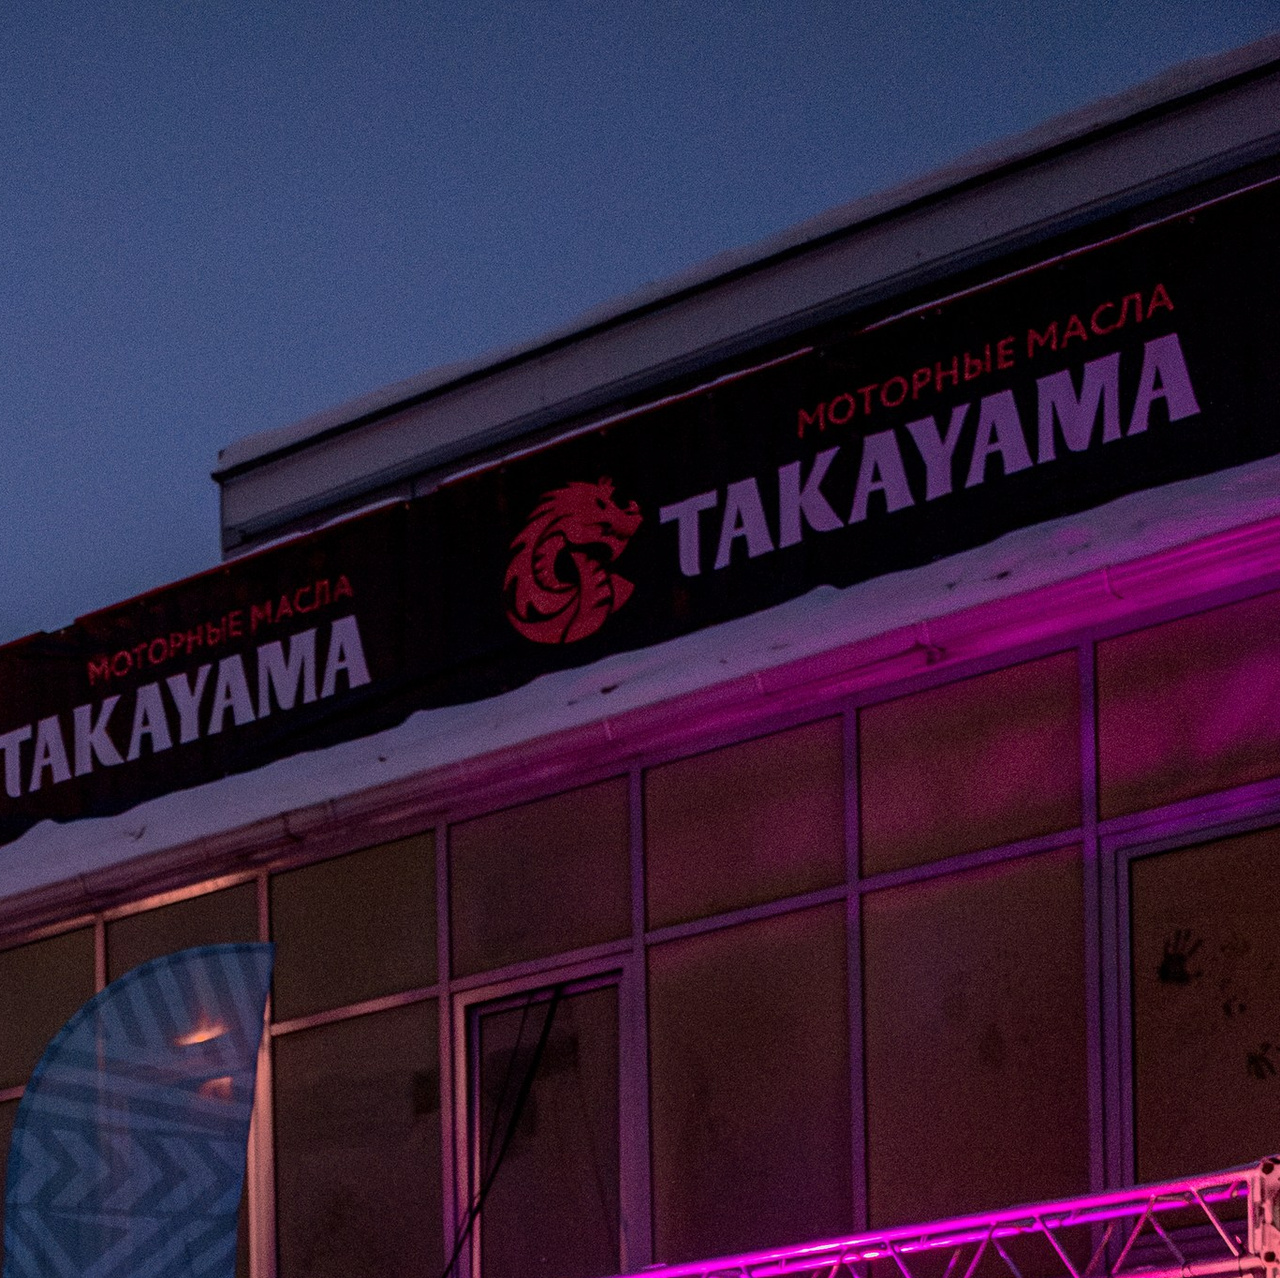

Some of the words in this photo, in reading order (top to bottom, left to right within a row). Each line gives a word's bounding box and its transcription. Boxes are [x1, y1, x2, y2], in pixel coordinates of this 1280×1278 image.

[796, 335, 1017, 439] МОТОРНЫЕ
[1026, 282, 1176, 360] МАСЛА
[659, 332, 1203, 577] TAKAYAMA
[85, 608, 244, 688] МОТОРНЫЕ
[250, 574, 355, 637] МАСЛА
